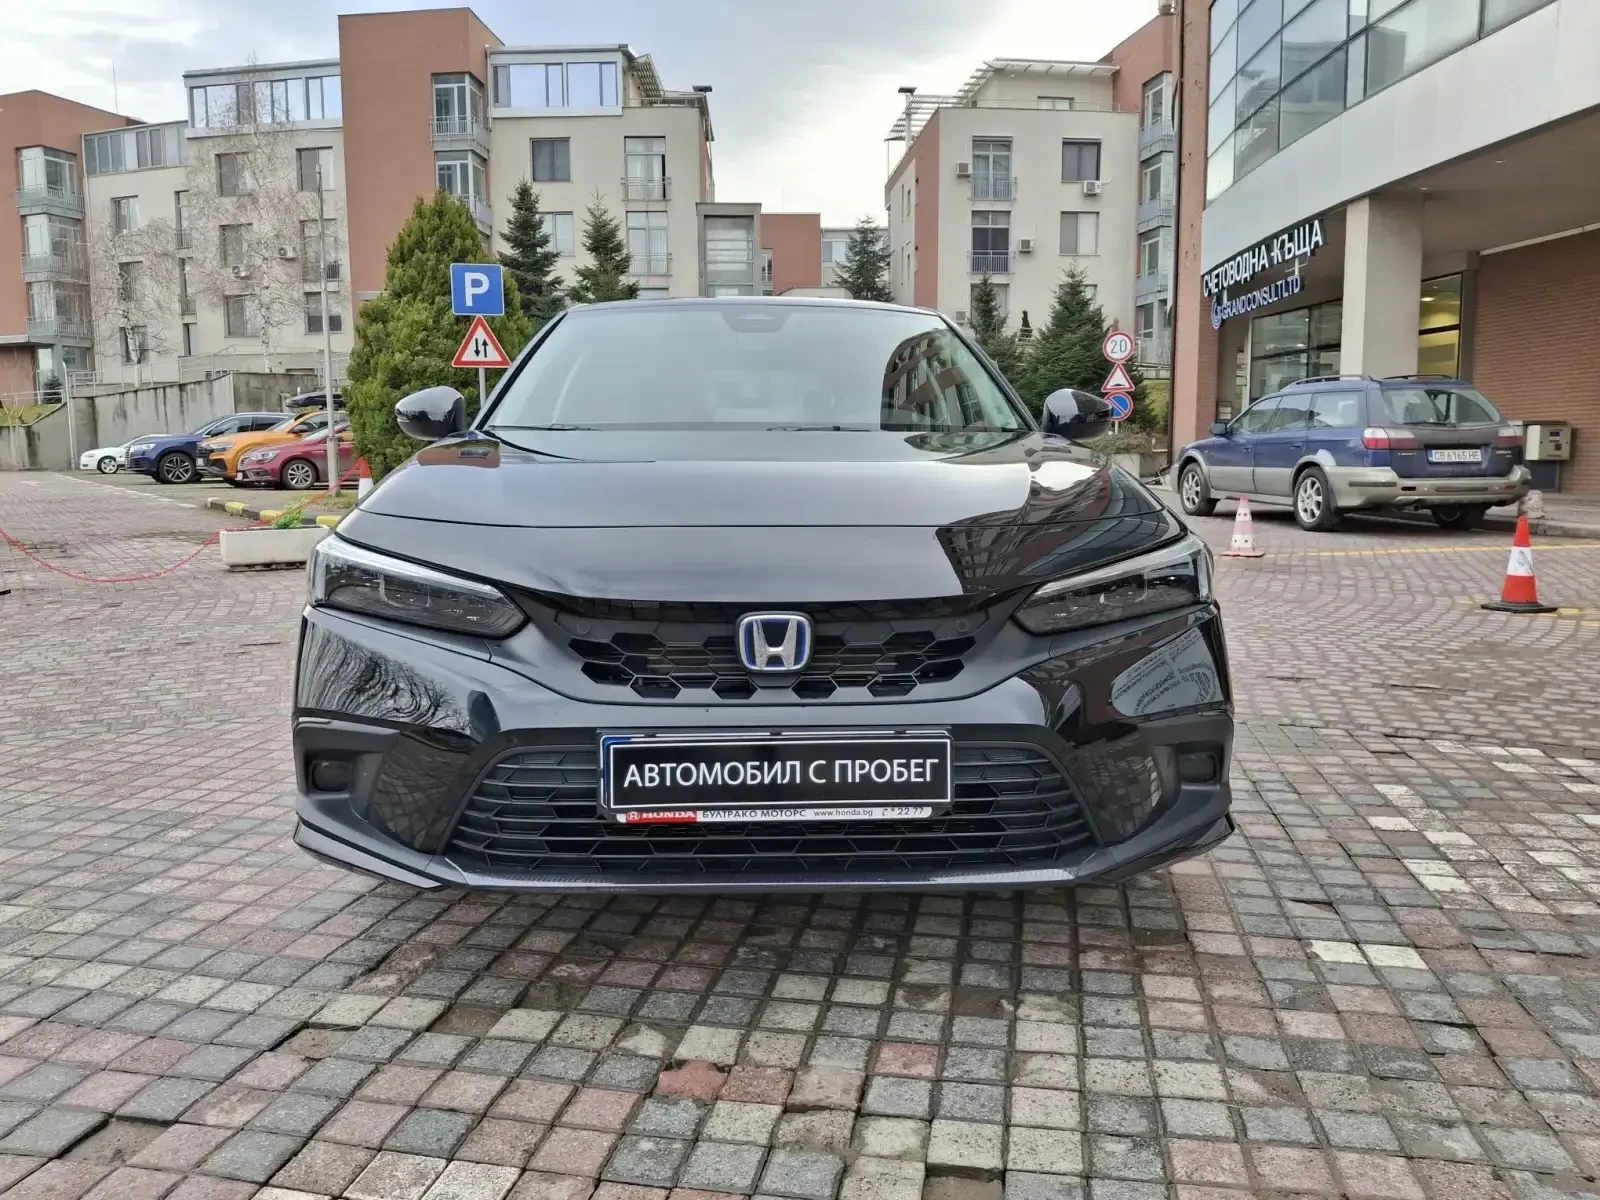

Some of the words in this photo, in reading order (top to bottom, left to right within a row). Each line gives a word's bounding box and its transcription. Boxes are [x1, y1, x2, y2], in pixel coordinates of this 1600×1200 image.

[1203, 244, 1269, 297] СЧЕТОВОДНА
[1274, 219, 1323, 265] КЪЩА
[464, 272, 490, 307] P
[1110, 339, 1127, 354] 20
[623, 760, 800, 788] АВТОМОБИЛ
[808, 759, 827, 784] С
[834, 758, 939, 783] ПРОБЕГ
[642, 810, 697, 819] HONDA
[702, 810, 757, 819] БУЛТРАКО
[760, 808, 807, 818] МОТОРС
[814, 807, 873, 817] www.honda.bg
